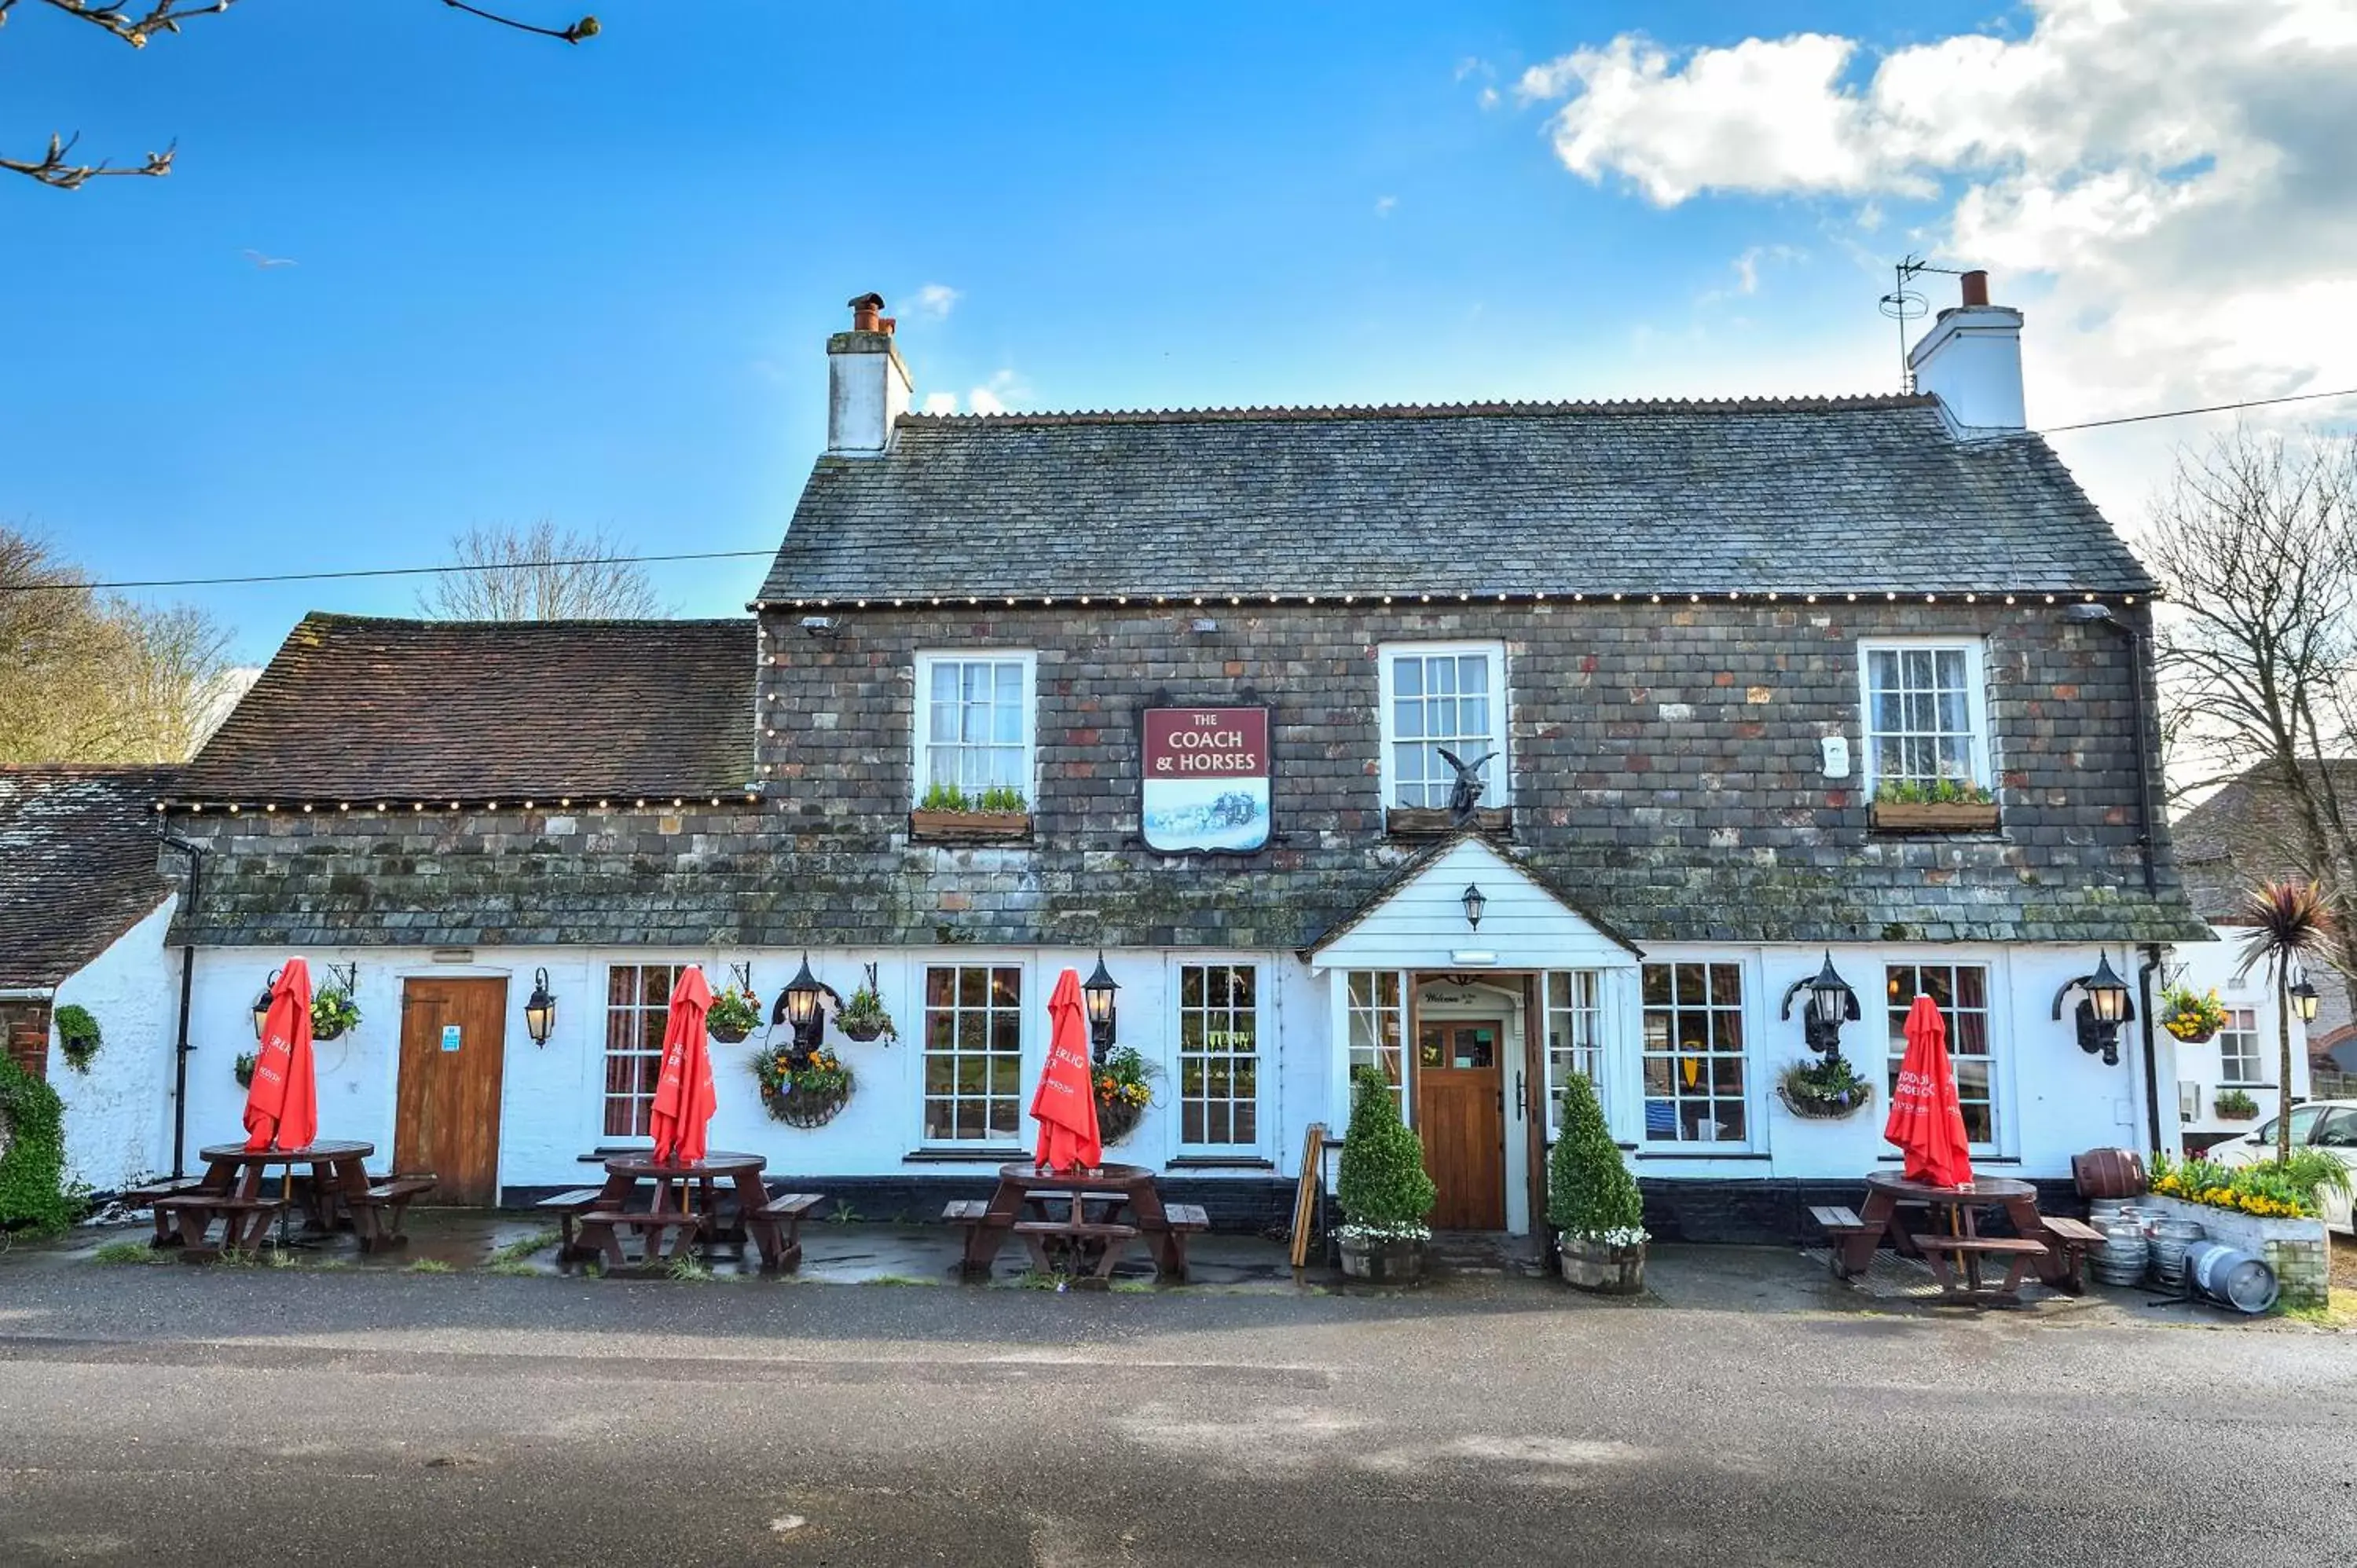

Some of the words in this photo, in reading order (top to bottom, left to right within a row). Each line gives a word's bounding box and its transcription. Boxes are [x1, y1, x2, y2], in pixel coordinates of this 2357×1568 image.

[1193, 714, 1218, 725] THE
[1168, 731, 1242, 749] COACH
[1156, 756, 1174, 771] &
[1179, 753, 1256, 771] HORSES
